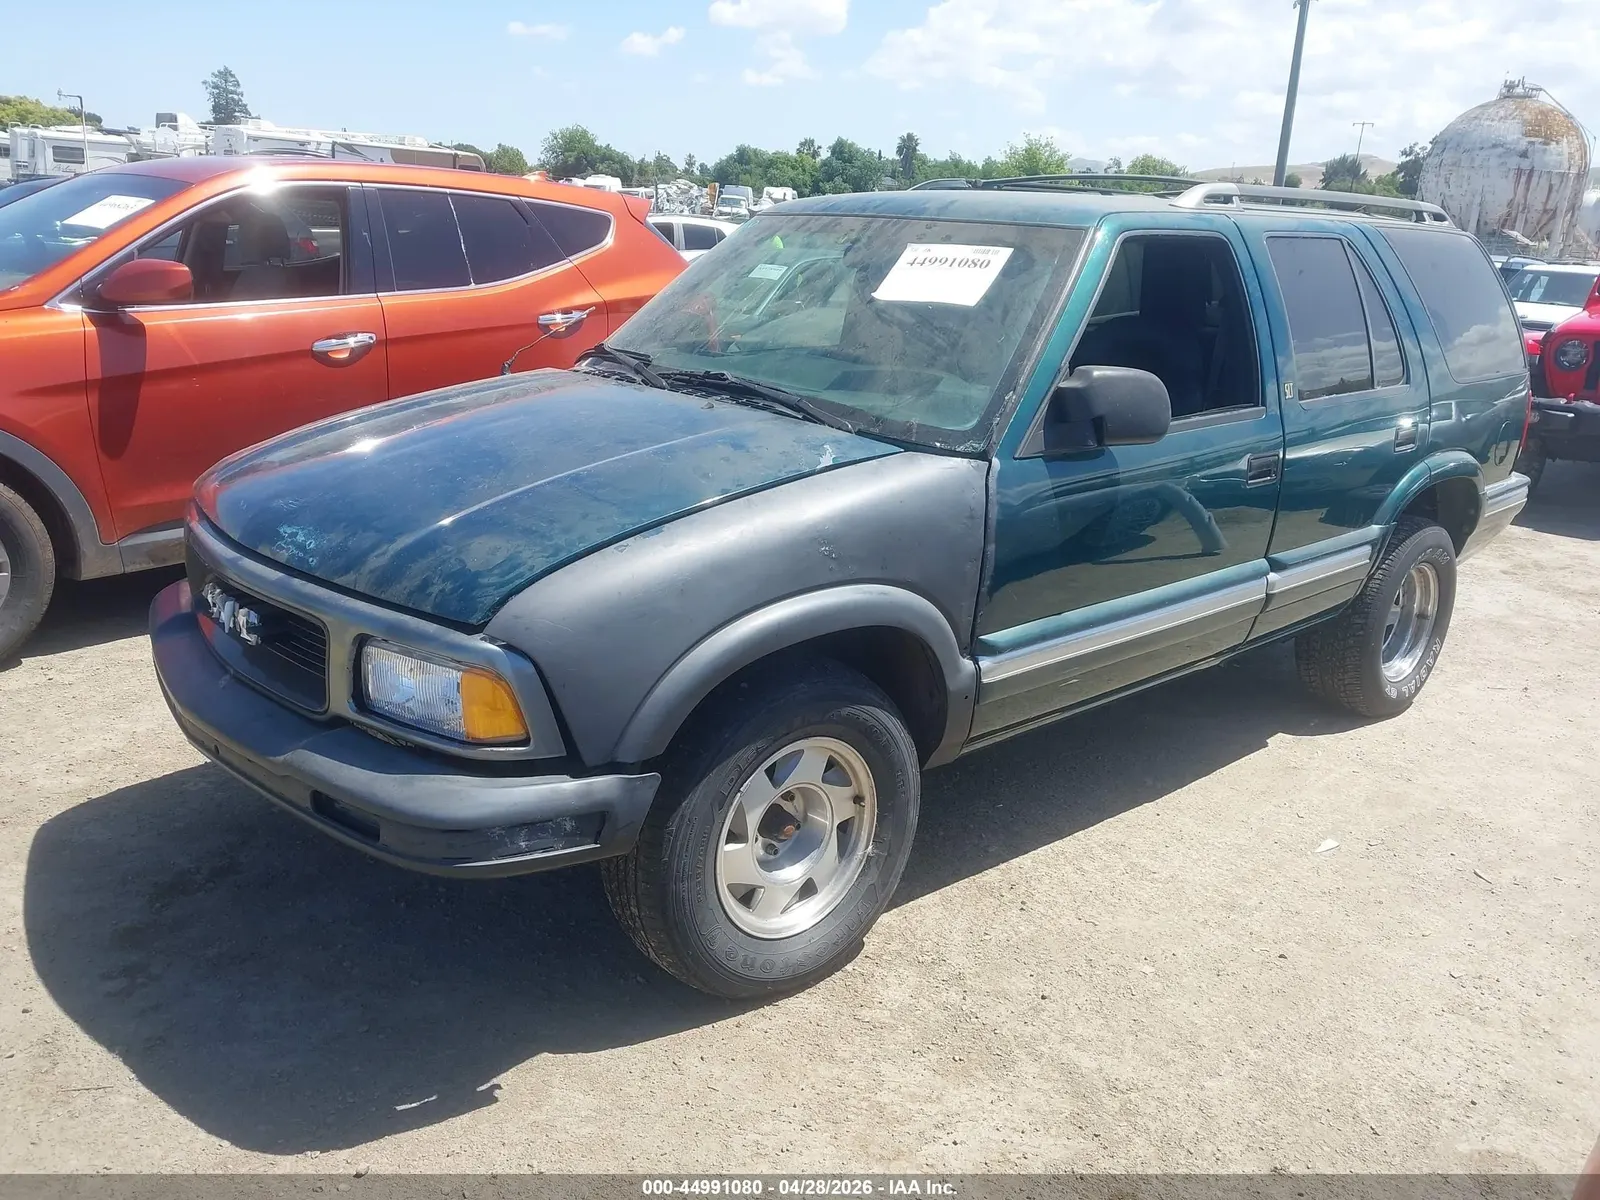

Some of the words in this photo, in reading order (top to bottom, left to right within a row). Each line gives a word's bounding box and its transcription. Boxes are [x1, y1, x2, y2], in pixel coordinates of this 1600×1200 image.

[906, 256, 992, 270] 44991080
[1401, 637, 1442, 697] RADIAL
[724, 898, 874, 976] Firestone
